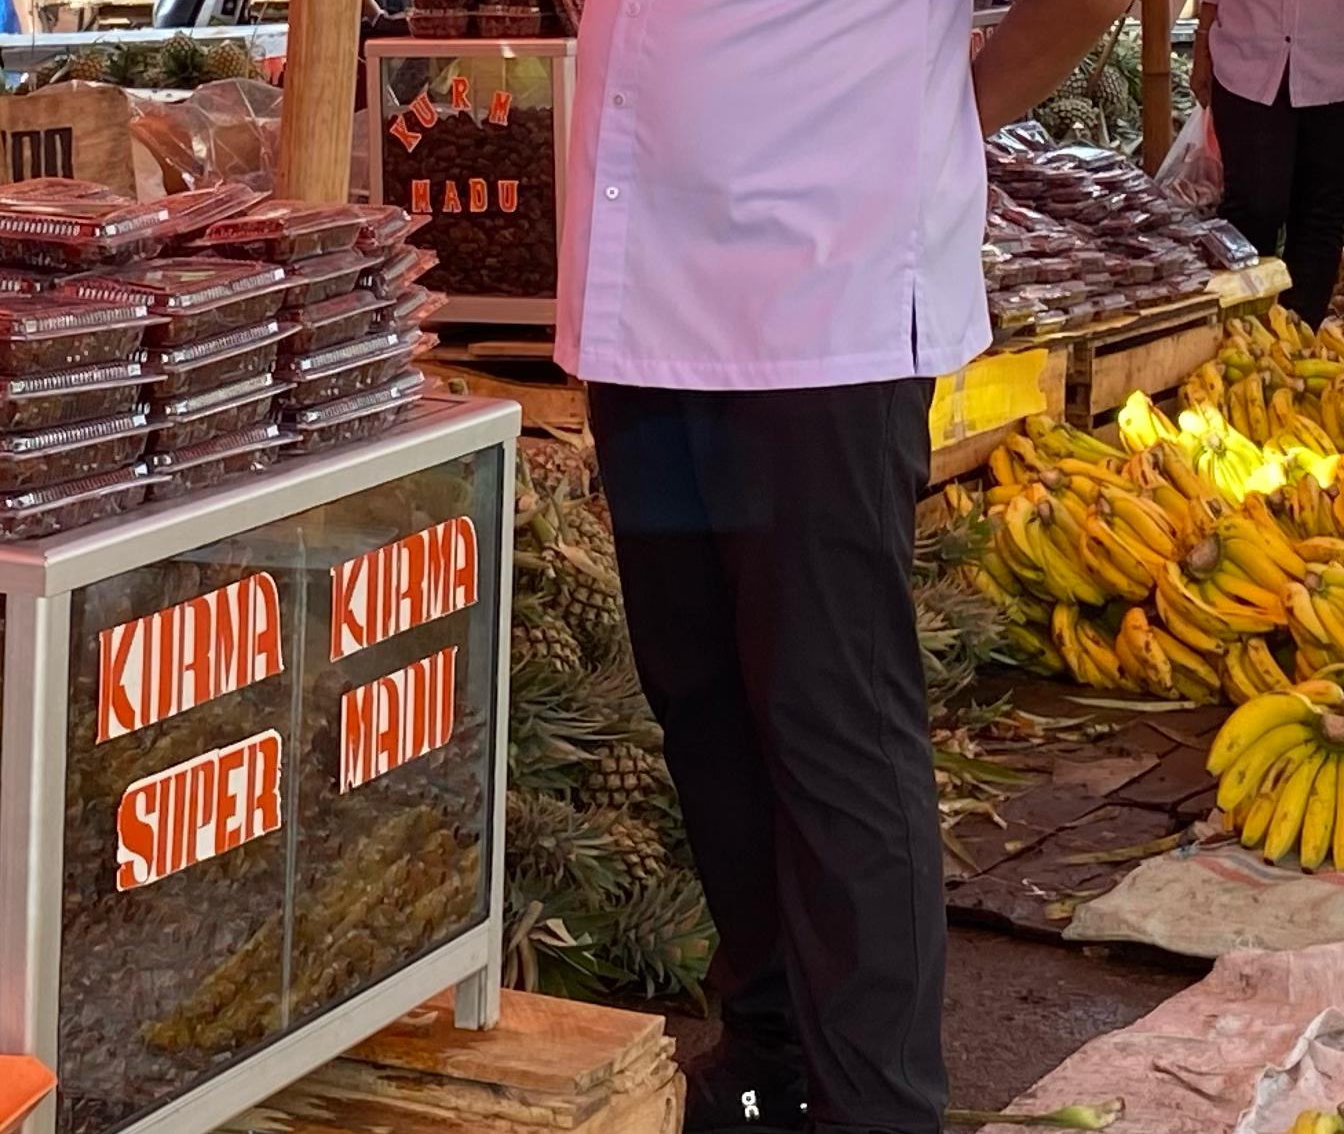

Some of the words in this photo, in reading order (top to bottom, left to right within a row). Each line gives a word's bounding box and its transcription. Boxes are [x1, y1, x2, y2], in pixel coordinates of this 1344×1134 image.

[411, 177, 519, 213] MADU
[96, 571, 284, 745] KURMA
[330, 516, 478, 663] KURMA
[340, 646, 458, 795] MADU
[117, 729, 282, 892] SUPER
